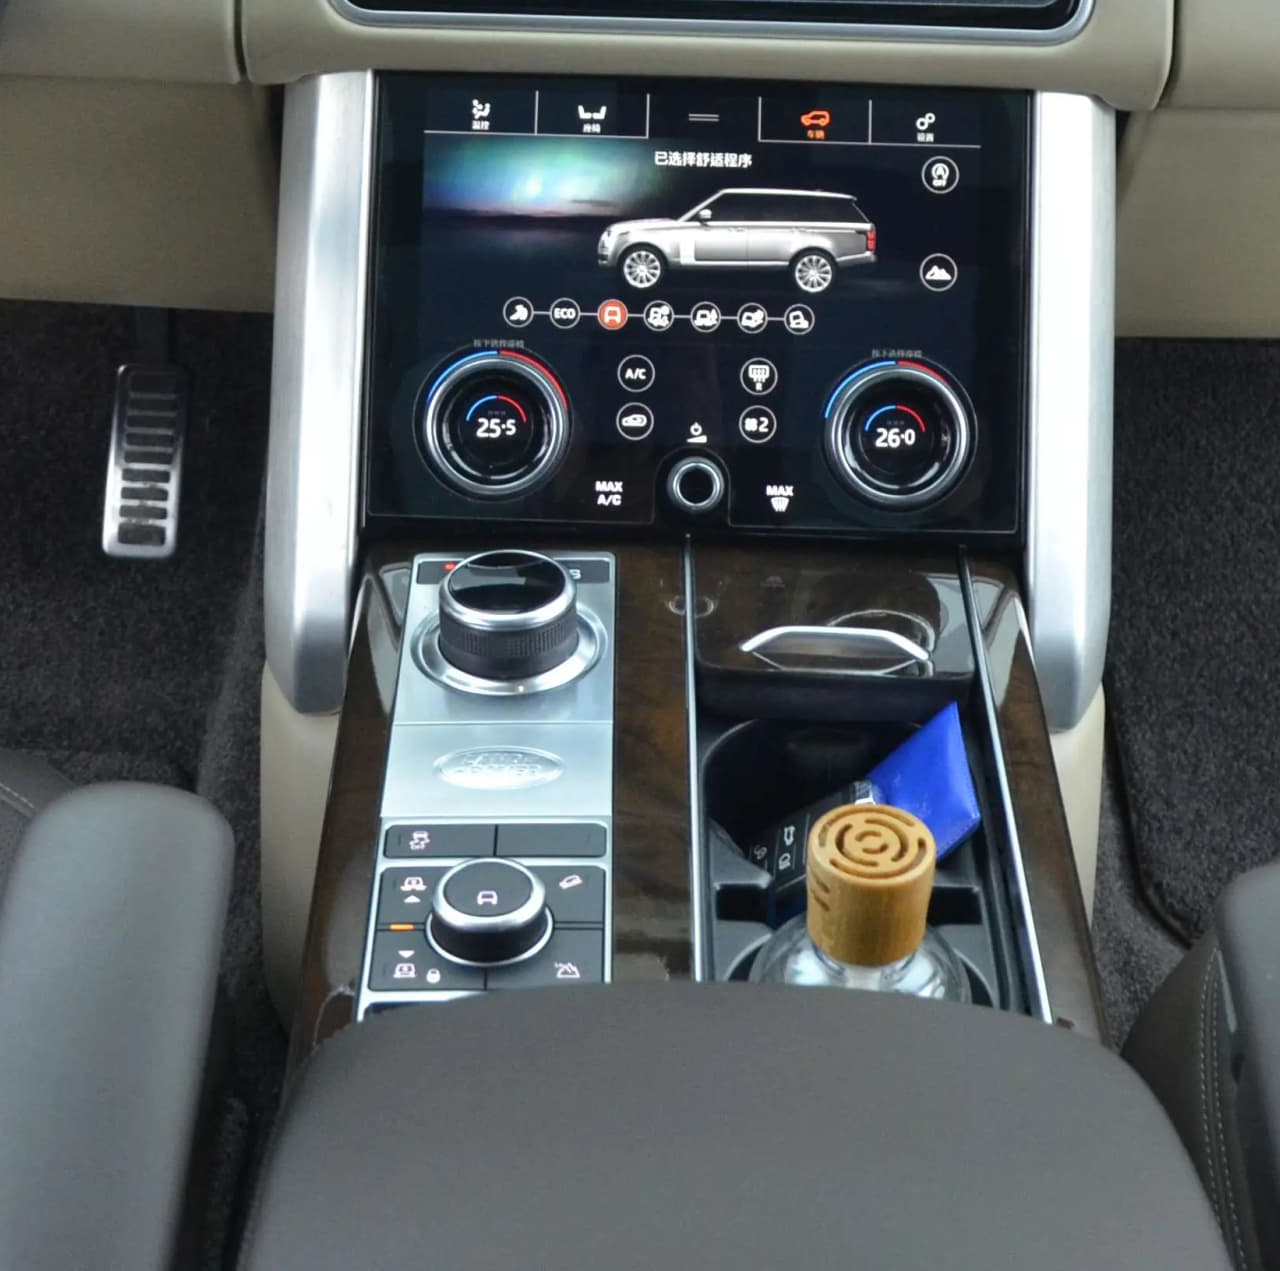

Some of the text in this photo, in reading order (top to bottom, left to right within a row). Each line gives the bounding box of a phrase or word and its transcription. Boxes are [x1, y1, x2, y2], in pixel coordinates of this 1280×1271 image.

[654, 151, 753, 168] 已选择舒适程序
[554, 308, 576, 319] ECO
[625, 368, 647, 380] A/C
[758, 417, 769, 432] 2
[595, 481, 623, 493] MAX
[766, 485, 794, 496] MAX
[597, 494, 622, 506] A/C
